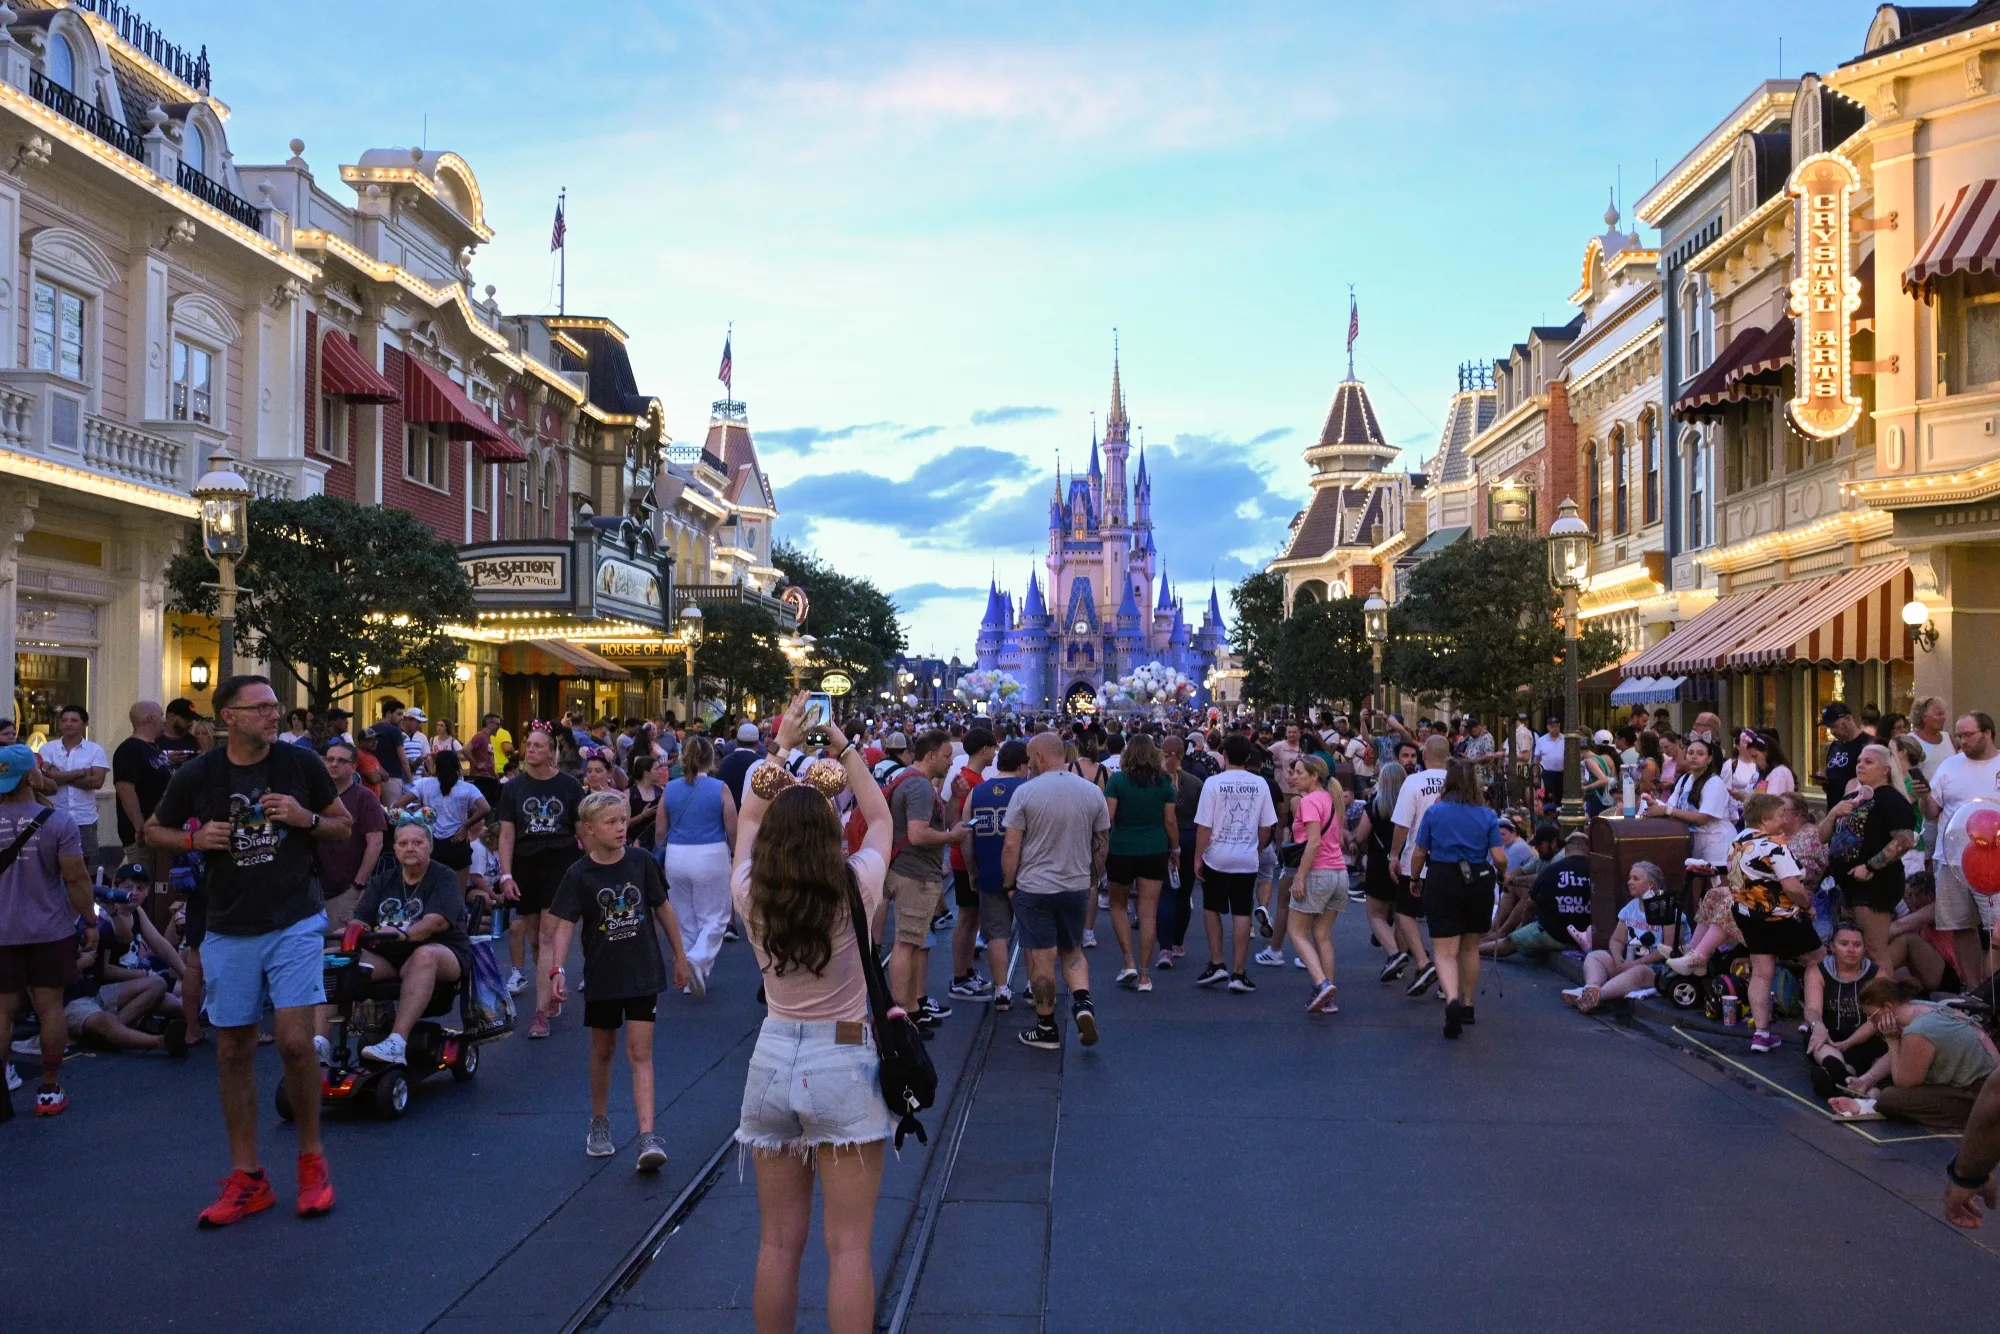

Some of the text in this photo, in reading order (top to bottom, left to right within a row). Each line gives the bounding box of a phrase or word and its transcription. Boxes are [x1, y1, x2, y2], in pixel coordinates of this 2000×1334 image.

[1812, 194, 1839, 398] CRYSTAL ARTS
[1497, 522, 1527, 532] COFFEE
[471, 561, 556, 587] FASHION
[512, 575, 559, 586] APPAREL
[600, 643, 640, 655] HOUSE
[643, 643, 660, 655] OF
[243, 855, 269, 866] 2025
[1555, 896, 1583, 904] YOU
